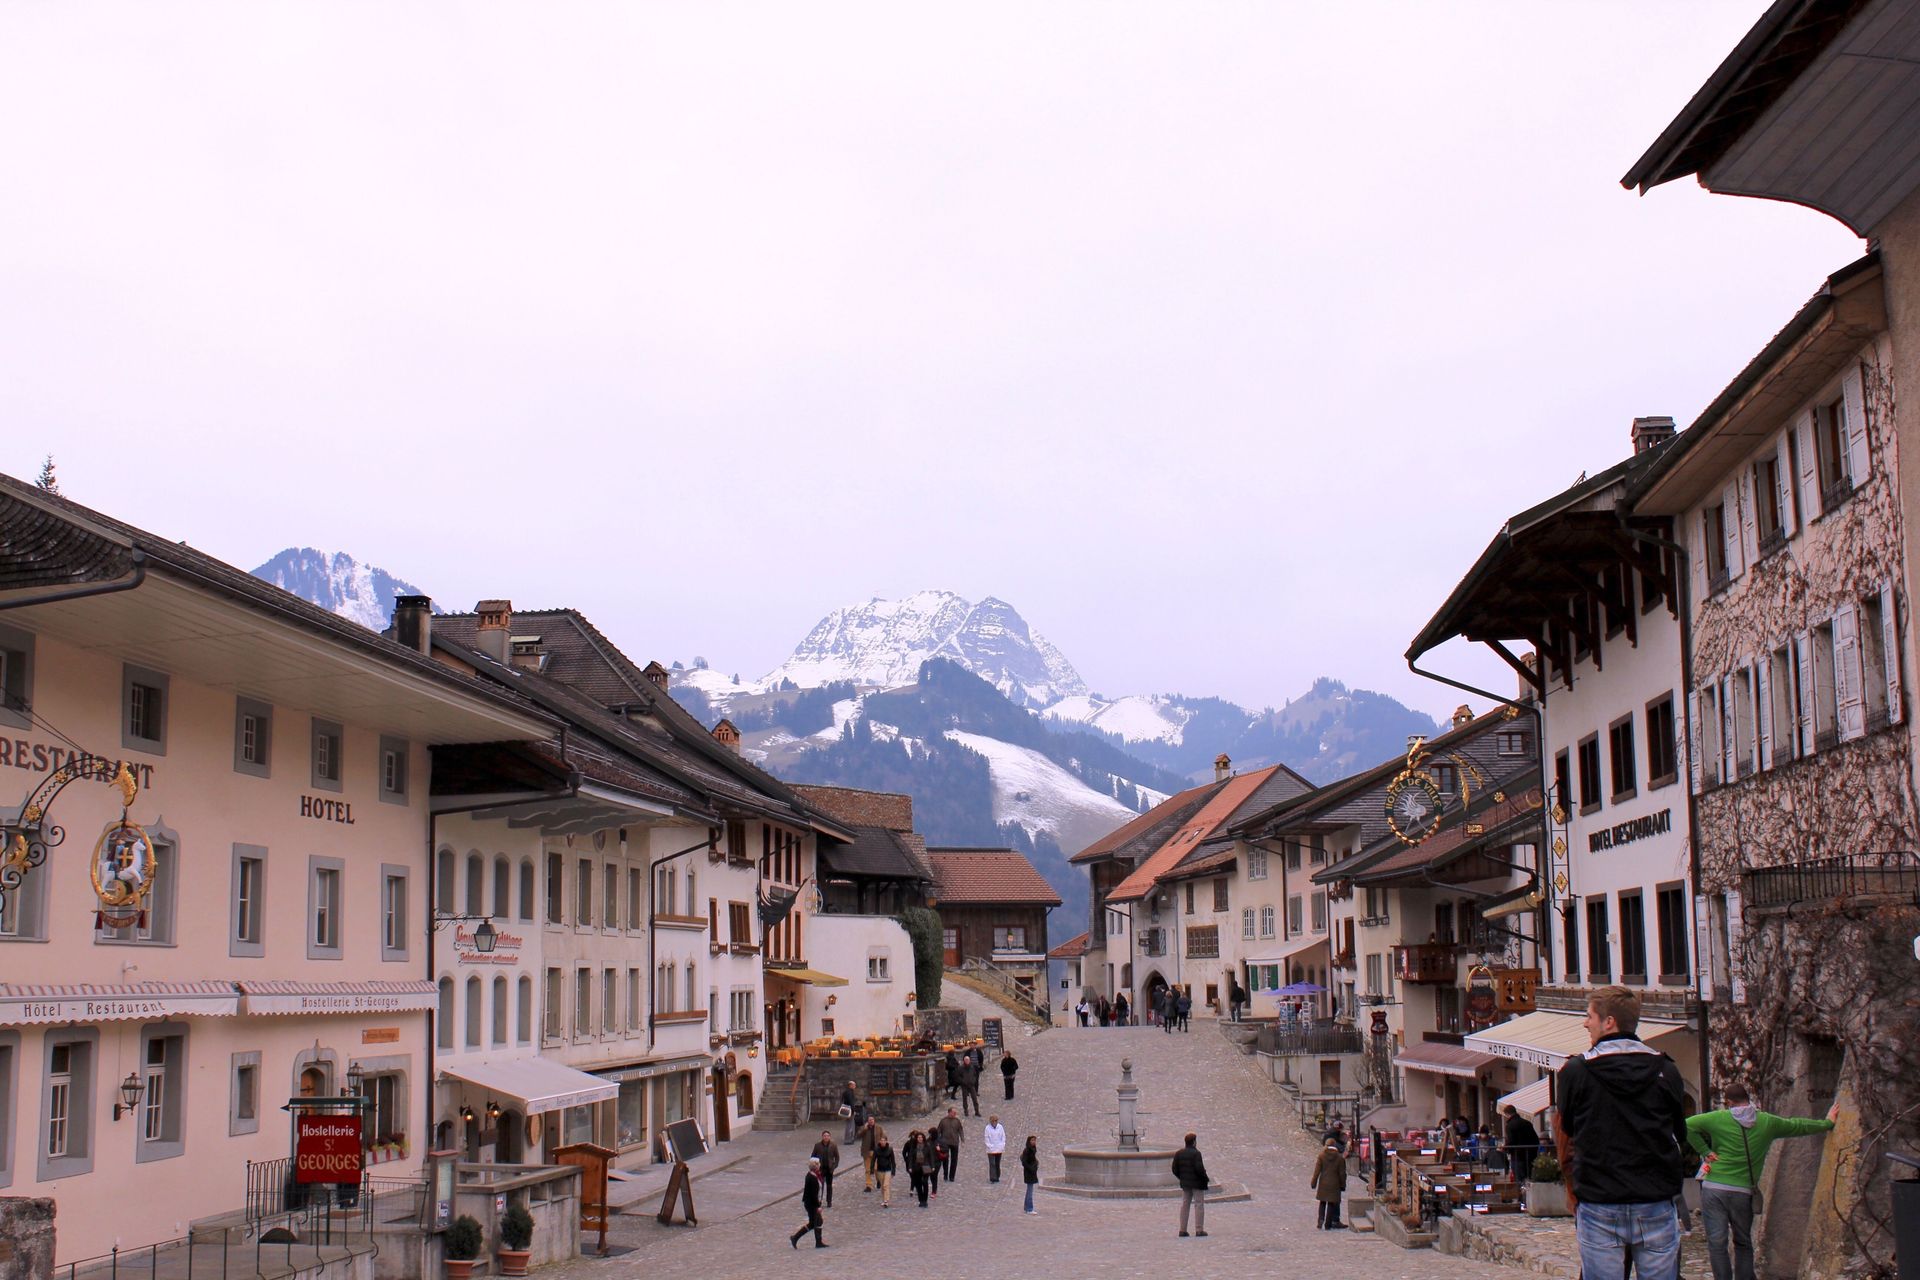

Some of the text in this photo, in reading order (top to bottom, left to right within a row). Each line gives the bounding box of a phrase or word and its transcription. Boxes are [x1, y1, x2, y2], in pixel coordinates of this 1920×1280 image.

[1386, 778, 1442, 809] HOTEL DE VILLE
[300, 795, 355, 824] HOTEL
[1588, 808, 1671, 853] HOTEL RESTAURANT
[24, 1002, 61, 1017] Hôtel
[87, 1001, 166, 1015] Restaurant
[302, 997, 399, 1008] Hostellerie St-Georges
[1488, 1044, 1550, 1066] HOTEL de VILLE
[302, 1123, 355, 1137] Hostellerie
[298, 1153, 360, 1174] GEORGES
